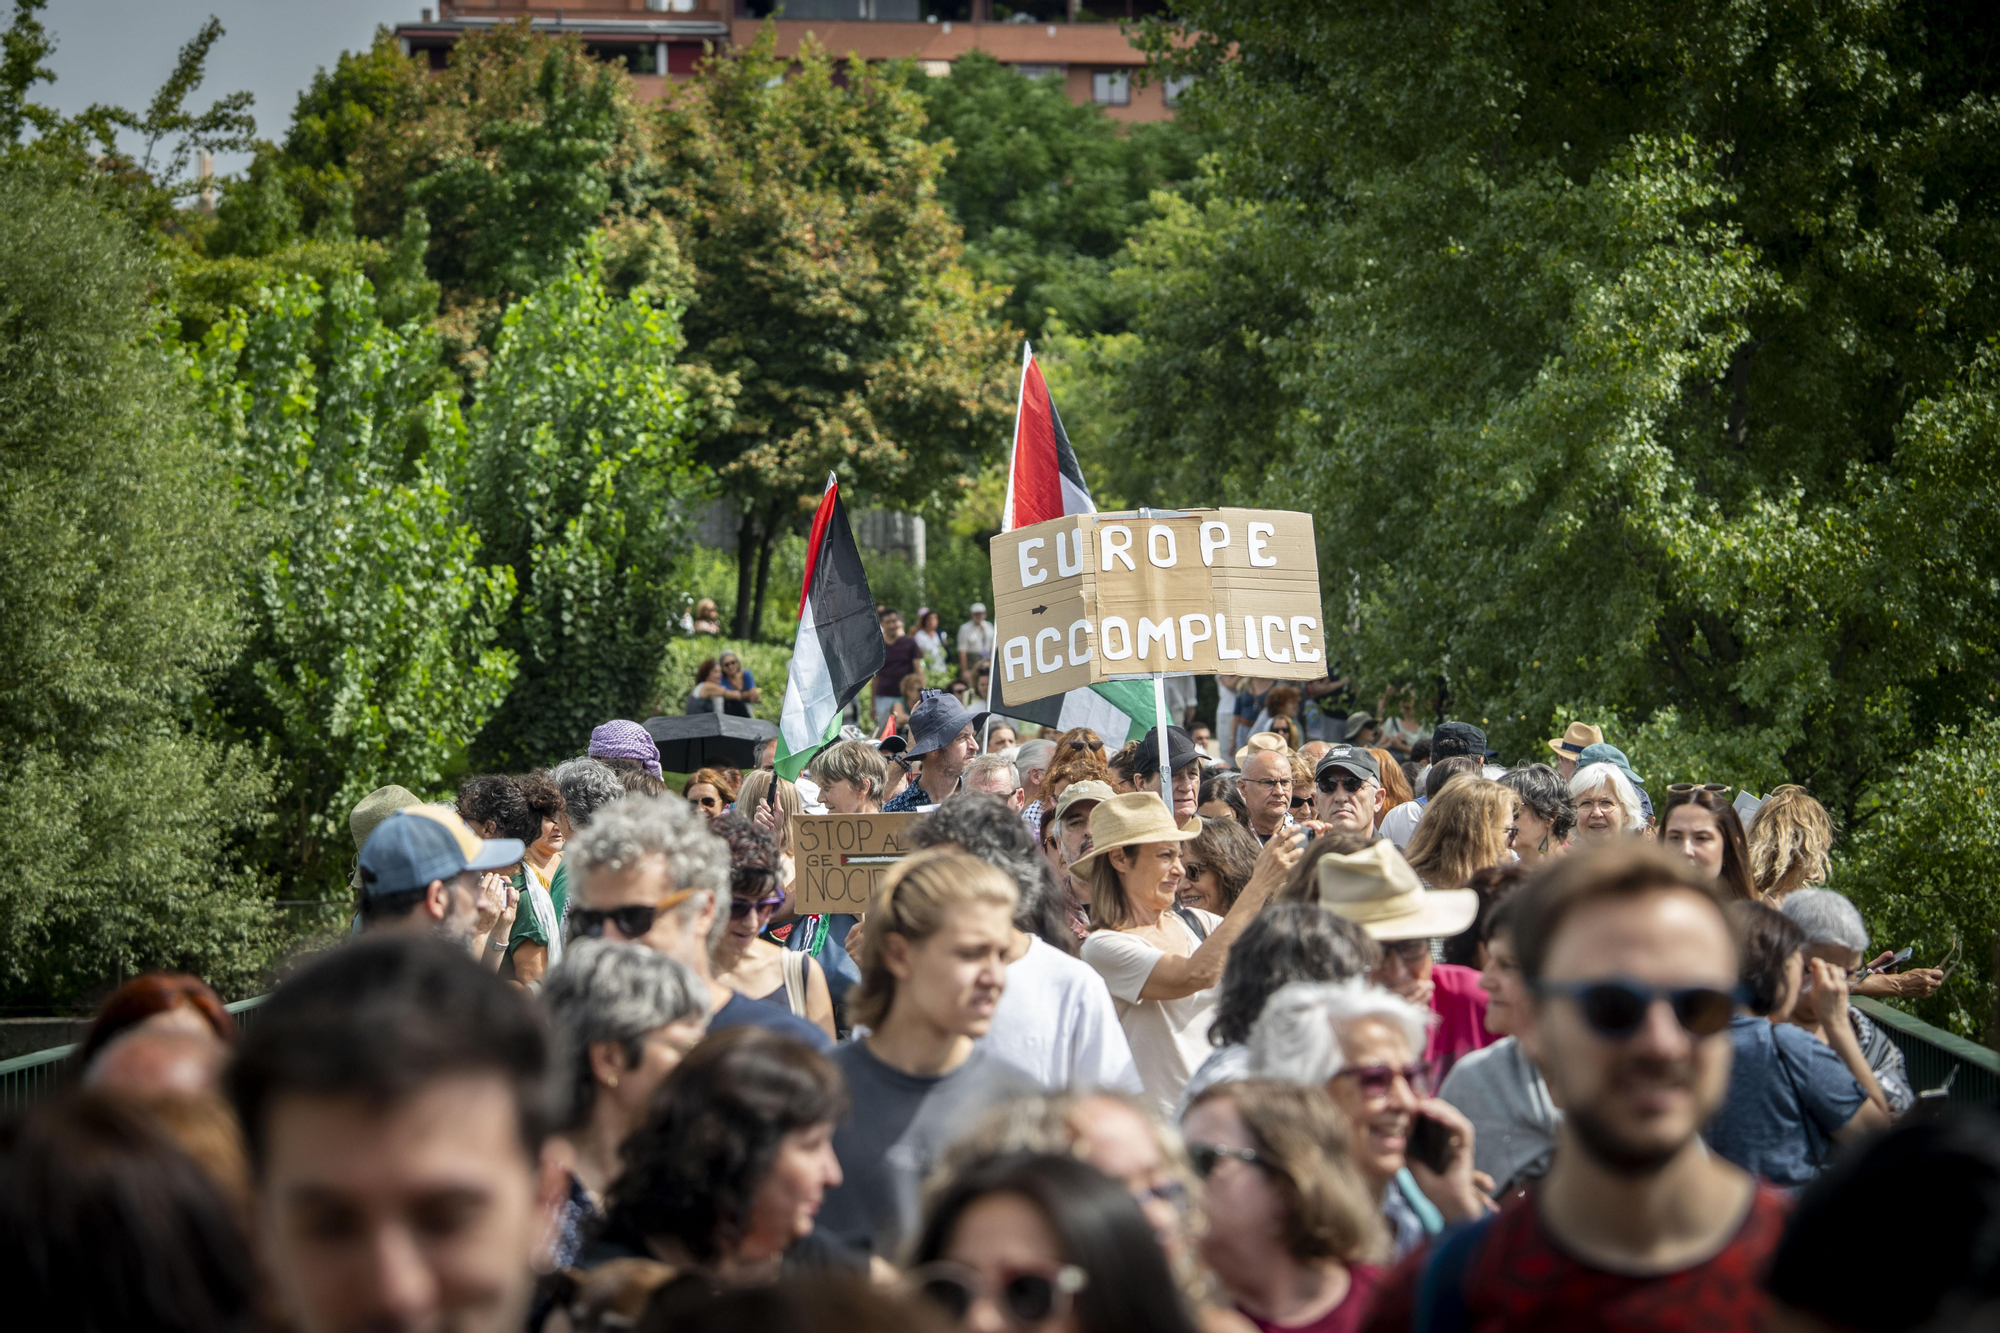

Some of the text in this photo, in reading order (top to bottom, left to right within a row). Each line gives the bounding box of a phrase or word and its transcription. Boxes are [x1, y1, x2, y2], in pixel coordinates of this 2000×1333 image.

[1018, 521, 1277, 587] EUROPE
[1003, 613, 1321, 682] ACCOMPLICE
[799, 819, 873, 851] STOP
[806, 854, 833, 866] GE
